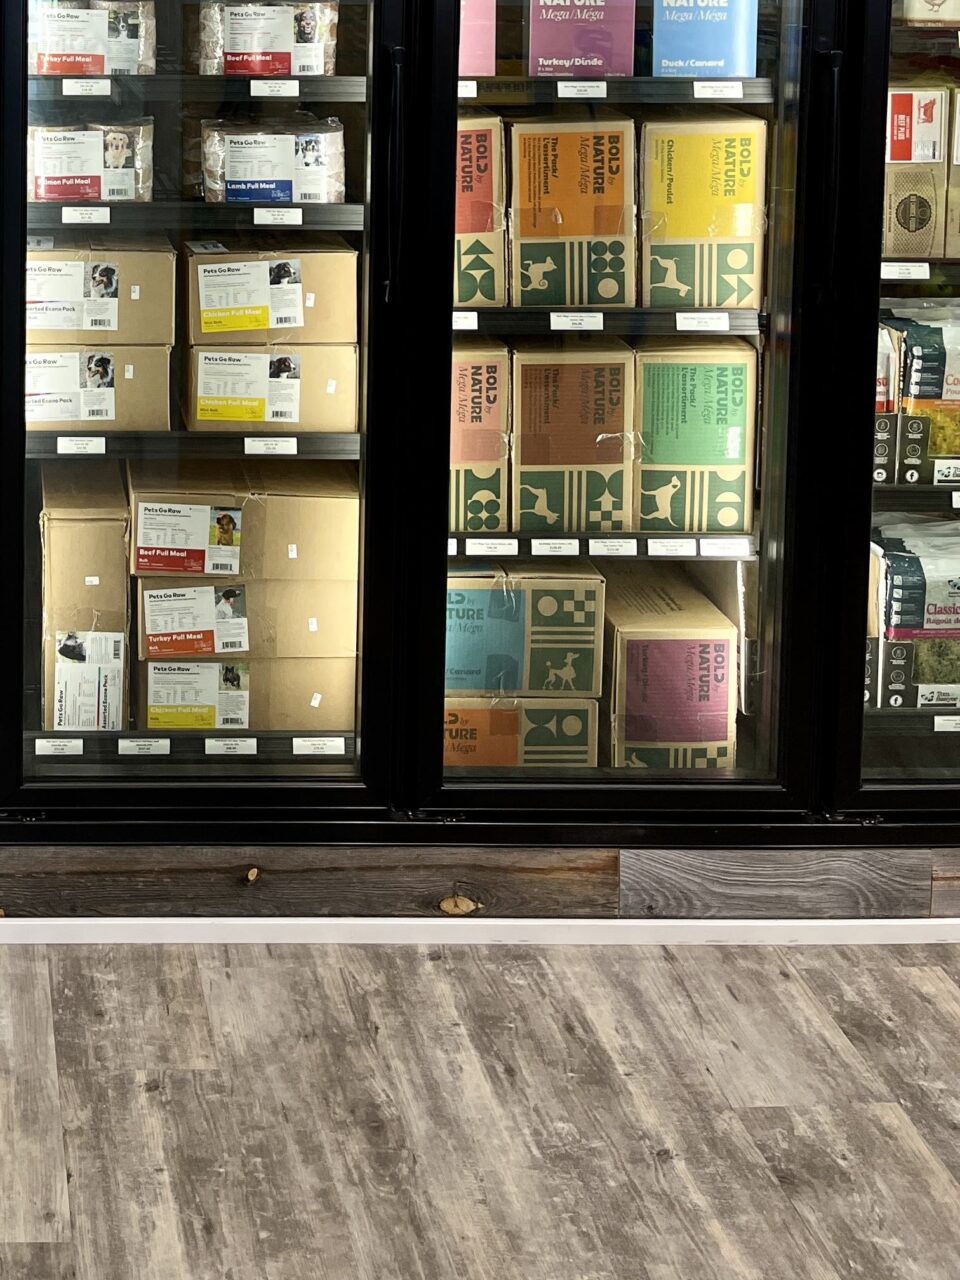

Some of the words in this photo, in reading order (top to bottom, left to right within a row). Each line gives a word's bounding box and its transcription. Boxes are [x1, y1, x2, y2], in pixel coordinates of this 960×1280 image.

[540, 8, 604, 21] Mega/Méga
[461, 135, 473, 192] NATURE
[476, 134, 487, 174] BOLD
[593, 136, 604, 194] NATURE
[608, 135, 620, 175] BOLD
[725, 138, 735, 197] NATURE
[227, 182, 244, 190] Lamb
[471, 366, 482, 423] NATURE
[594, 367, 605, 425] NATURE
[717, 367, 728, 425] NATURE
[149, 635, 171, 643] Turkey
[714, 644, 725, 683] BOLD
[699, 644, 710, 702] NATURE
